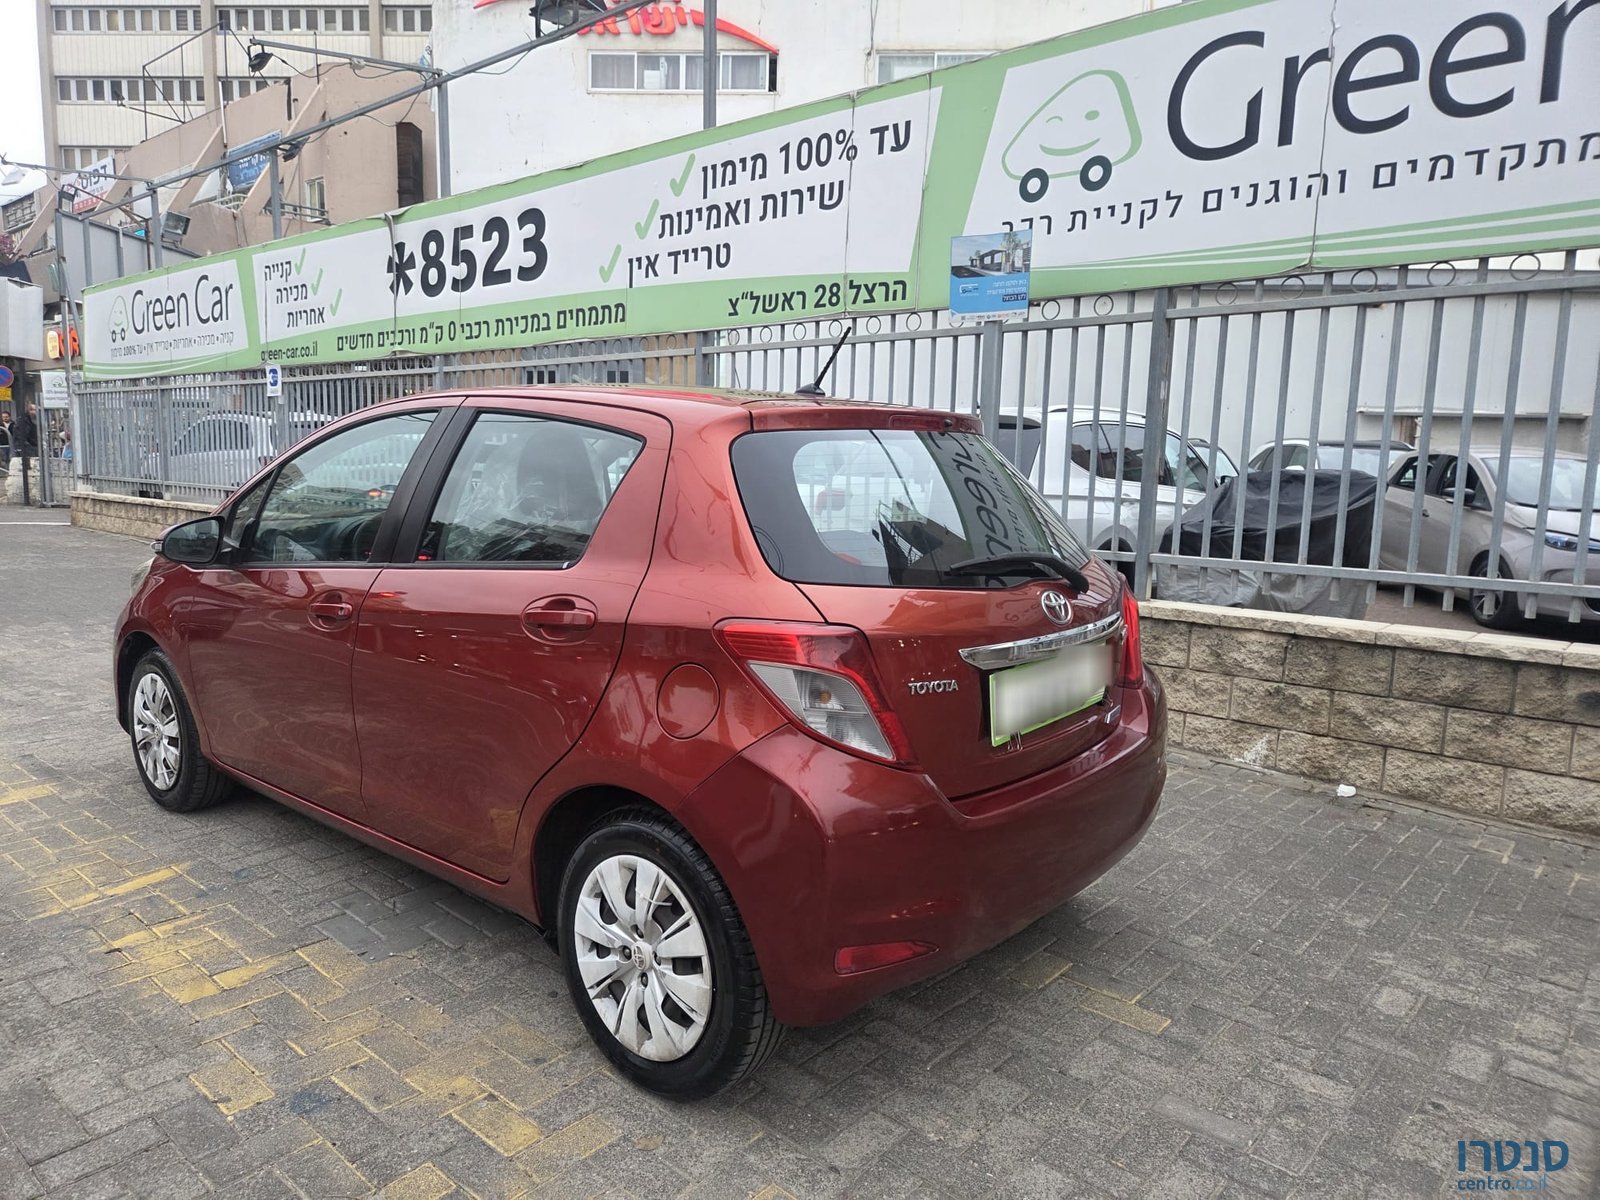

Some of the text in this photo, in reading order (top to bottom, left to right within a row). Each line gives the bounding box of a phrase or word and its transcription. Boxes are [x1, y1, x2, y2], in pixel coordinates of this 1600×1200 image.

[702, 119, 912, 200] עד 100% מימון
[1201, 168, 1348, 214] והוגנים
[658, 179, 845, 239] שירות ואמינות
[1067, 190, 1183, 234] לקניית
[264, 260, 292, 283] קנייה
[627, 242, 732, 289] טרייד אין
[131, 274, 234, 335] Green Car
[276, 283, 308, 304] מכירה
[813, 282, 842, 308] 28
[848, 279, 908, 306] הרצל
[286, 306, 325, 329] אחריות
[494, 312, 552, 338] במכירת
[556, 302, 627, 330] מתמחים
[336, 332, 374, 352] חדשים
[448, 320, 457, 342] 0
[460, 319, 491, 341] רכבי
[907, 679, 960, 695] TOYOTA
